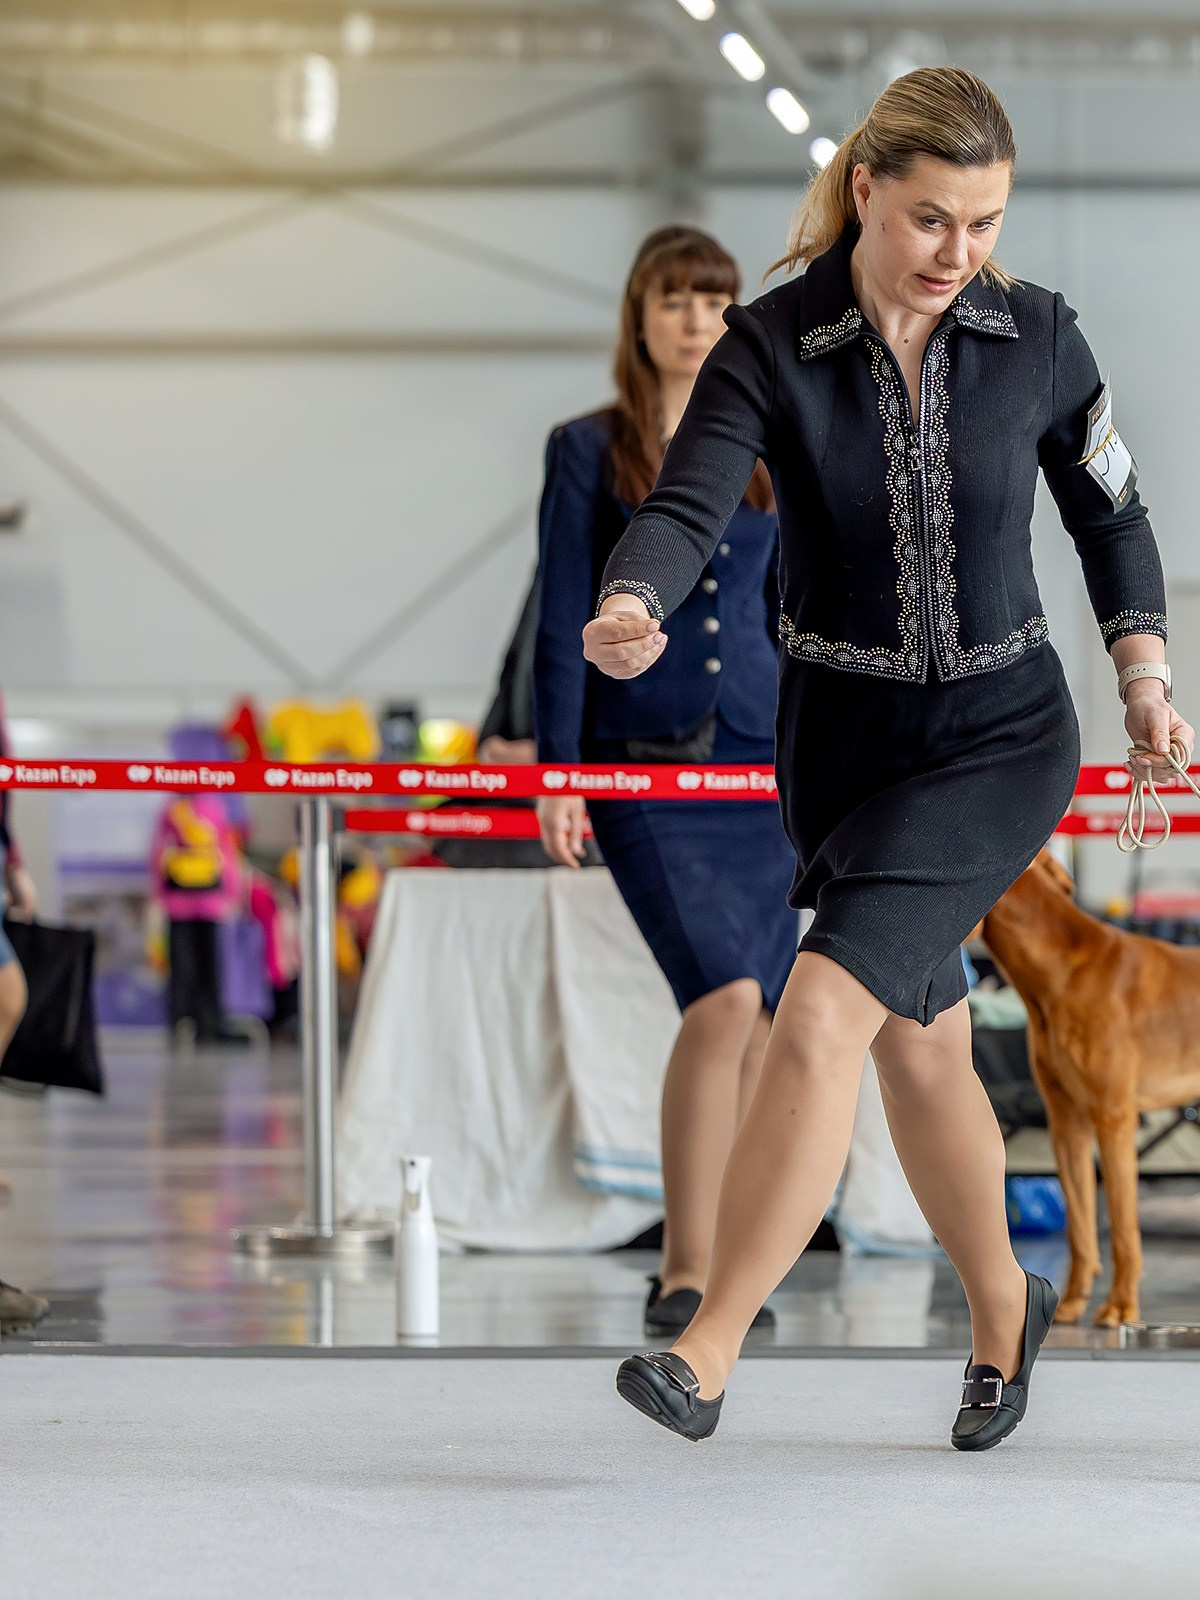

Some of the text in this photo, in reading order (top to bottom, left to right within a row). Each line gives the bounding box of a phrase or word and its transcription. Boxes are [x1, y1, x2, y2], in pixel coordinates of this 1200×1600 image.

[15, 765, 97, 786] Kazan Expo
[154, 766, 236, 787] Kazan Expo
[291, 769, 373, 790] Kazan Expo
[425, 770, 507, 792] Kazan Expo
[569, 771, 652, 793] Kazan Expo
[703, 771, 776, 793] Kazan Exp
